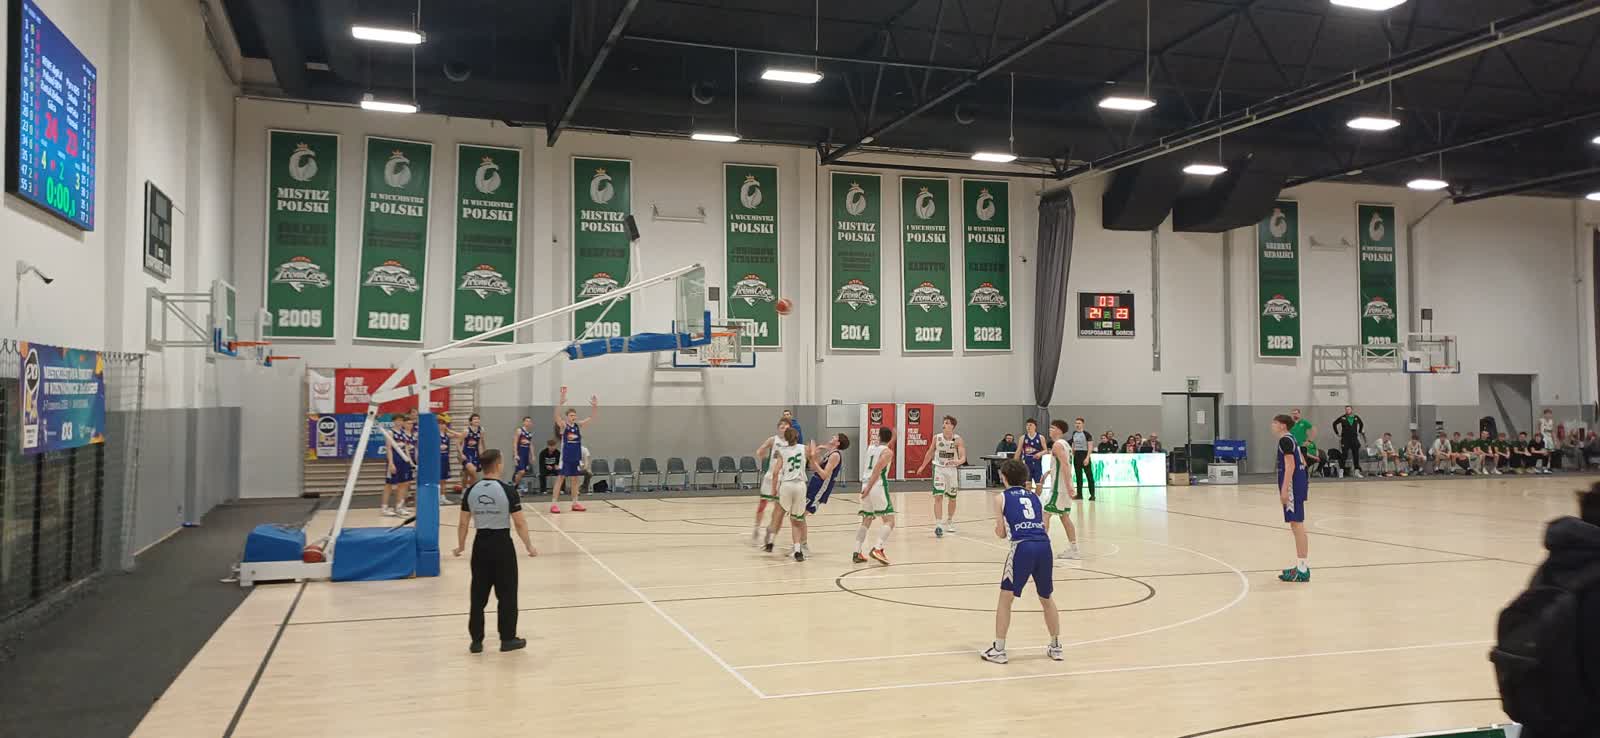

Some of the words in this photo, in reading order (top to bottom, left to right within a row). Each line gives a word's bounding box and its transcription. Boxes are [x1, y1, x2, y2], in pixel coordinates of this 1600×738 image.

[277, 187, 330, 201] MISTRZ
[277, 199, 329, 213] POLSKI
[369, 201, 424, 217] POLSKI
[462, 207, 513, 222] POLSKI
[580, 209, 624, 222] MISTRZ
[580, 221, 624, 233] POLSKI
[731, 222, 774, 234] POLSKI
[837, 221, 876, 232] MISTRZ
[837, 231, 876, 242] POLSKI
[906, 233, 946, 243] POLSKI
[967, 233, 1005, 244] POLSKI
[1362, 252, 1392, 262] POLSKI
[279, 308, 322, 328] 2005
[368, 311, 410, 331] 2006
[464, 314, 504, 332] 2007
[584, 321, 621, 338] 2009
[840, 325, 871, 341] 2014
[915, 327, 943, 342] 2017
[974, 327, 1003, 342] 2022
[1267, 335, 1294, 349] 2023
[787, 452, 802, 472] 35
[868, 455, 874, 470] 1
[1019, 497, 1036, 520] 3
